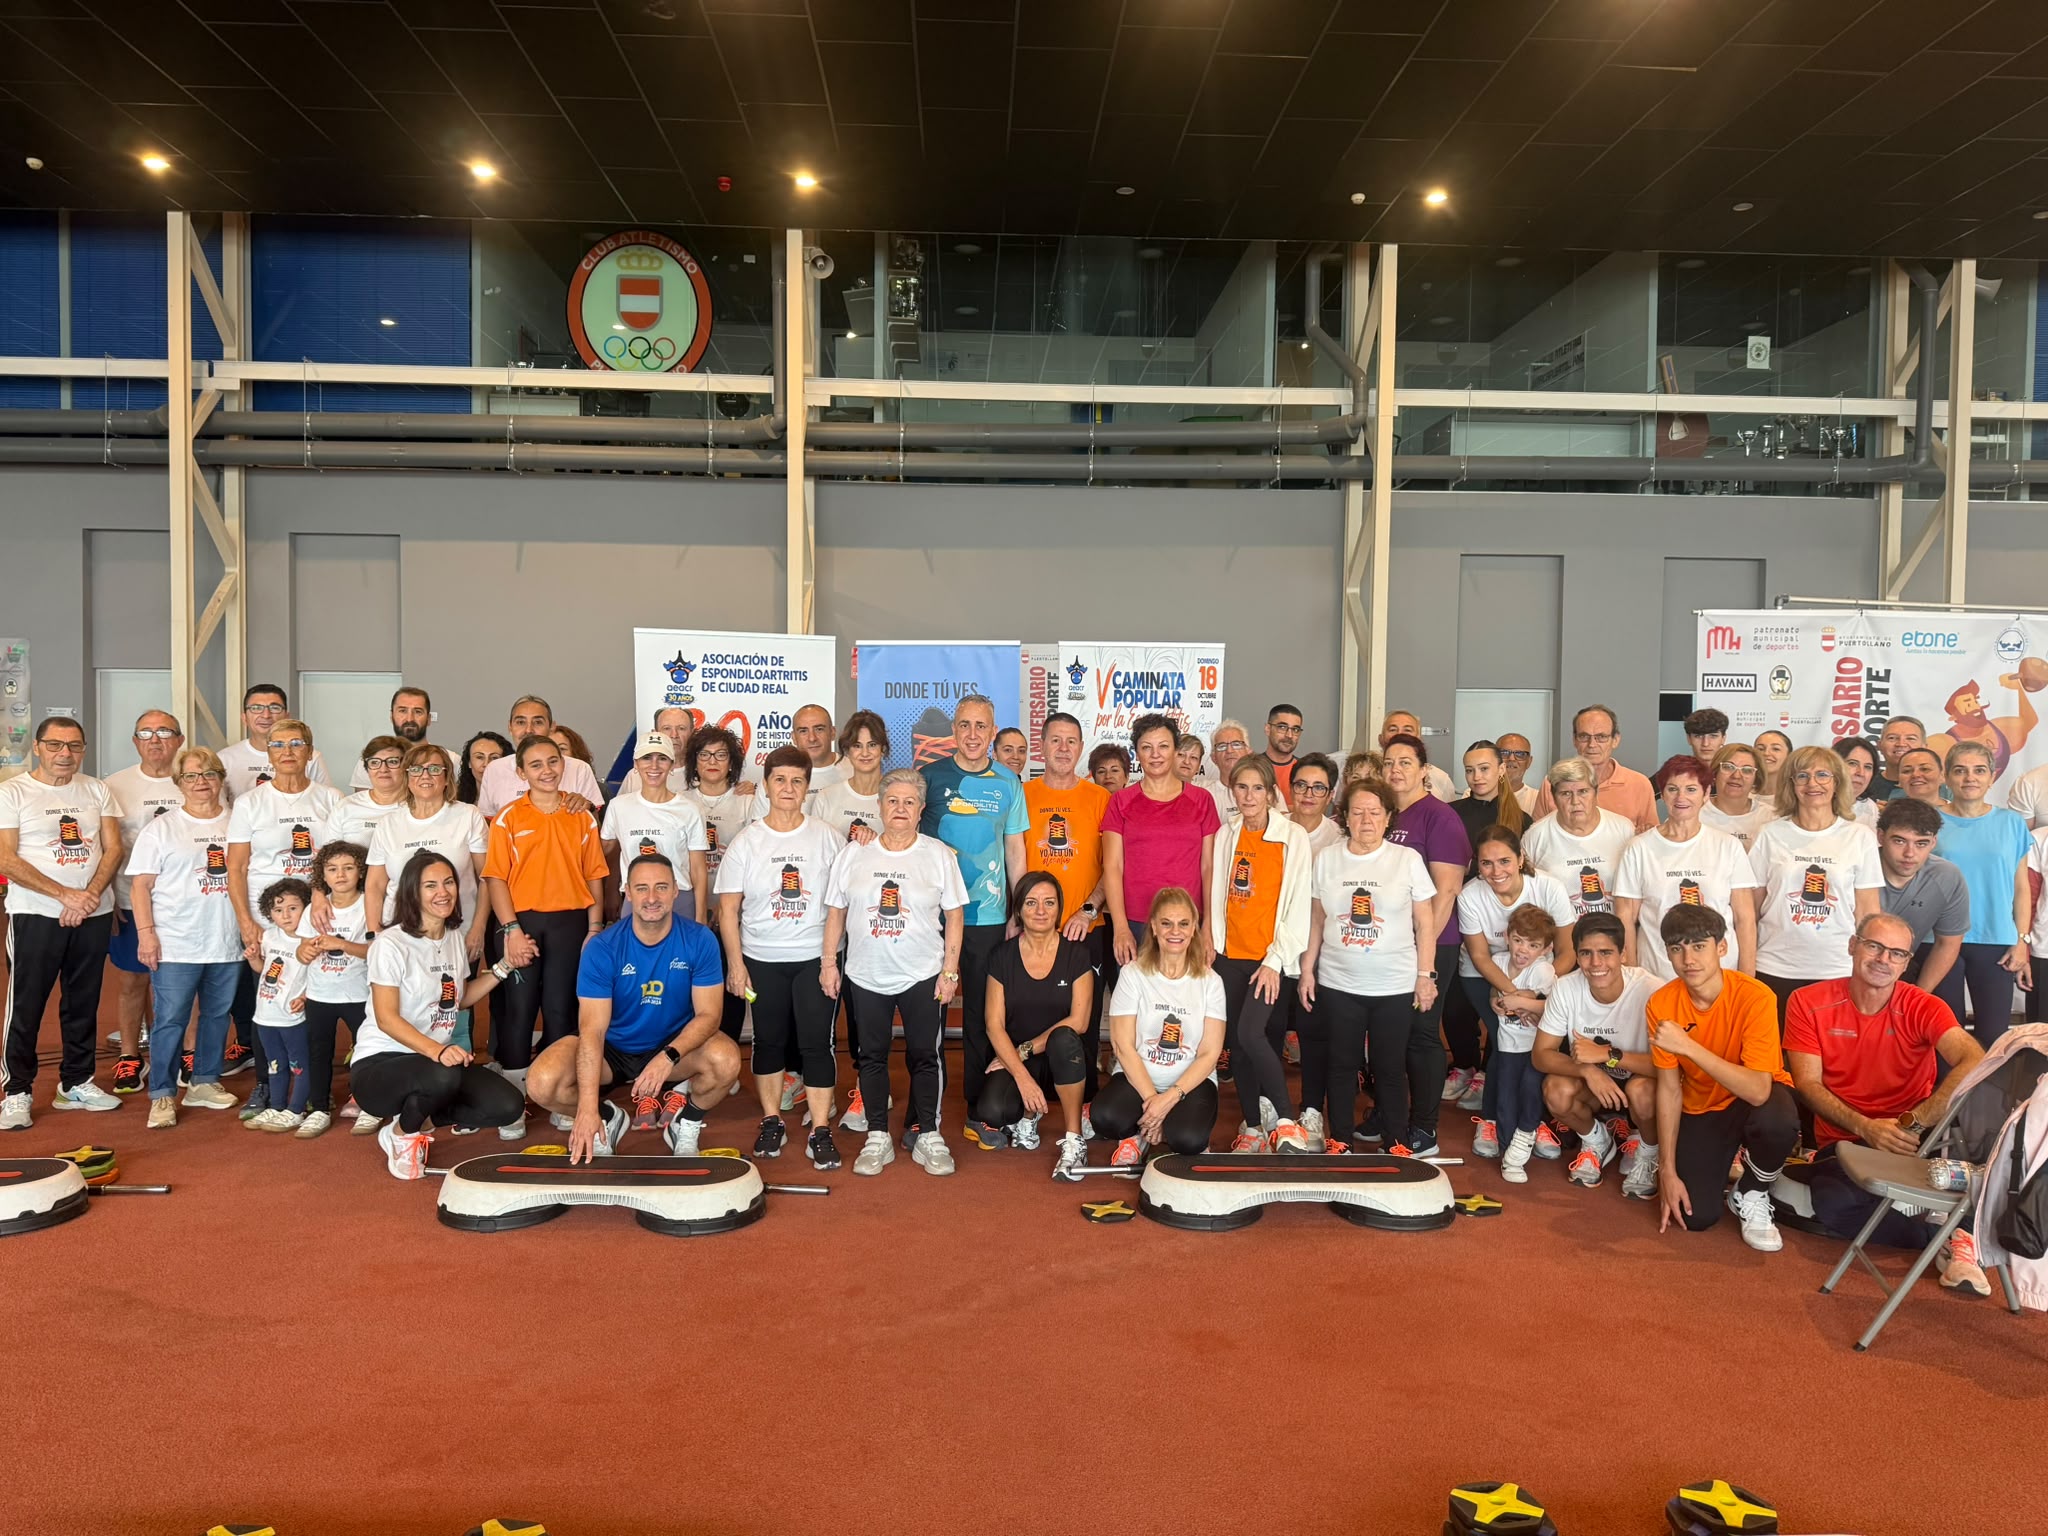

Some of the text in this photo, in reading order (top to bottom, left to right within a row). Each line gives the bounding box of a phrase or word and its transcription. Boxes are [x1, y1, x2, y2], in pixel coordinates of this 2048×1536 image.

[581, 231, 699, 275] CLUB ATLETISMO
[1753, 635, 1799, 643] municipal
[1839, 640, 1891, 648] PUERTOLLANO
[1765, 643, 1799, 651] deportes
[701, 652, 785, 666] ASOCIACIÓN DE
[701, 668, 808, 681] ESPONDILOARTRITIS
[1199, 666, 1217, 690] 18
[666, 684, 693, 692] aeacr
[701, 681, 789, 694] DE CIUDAD REAL
[1096, 659, 1186, 709] V CAMINATA
[1706, 677, 1752, 688] HAVANA
[884, 682, 929, 699] DONDE
[932, 679, 949, 699] TÚ
[1047, 671, 1059, 717] PORTE
[677, 694, 693, 702] AÑOS
[1113, 690, 1181, 709] POPULAR
[757, 711, 792, 729] AÑO
[1094, 703, 1125, 736] por la
[757, 731, 792, 740] DE HISTO
[1063, 849, 1073, 857] UN
[771, 902, 780, 910] YO
[796, 902, 807, 910] UN
[1790, 904, 1800, 913] YO
[1819, 905, 1831, 915] UN
[869, 919, 879, 928] YO
[894, 920, 905, 929] UN
[1341, 926, 1349, 935] YO
[1368, 928, 1378, 938] UN
[1155, 1003, 1170, 1011] DONDE
